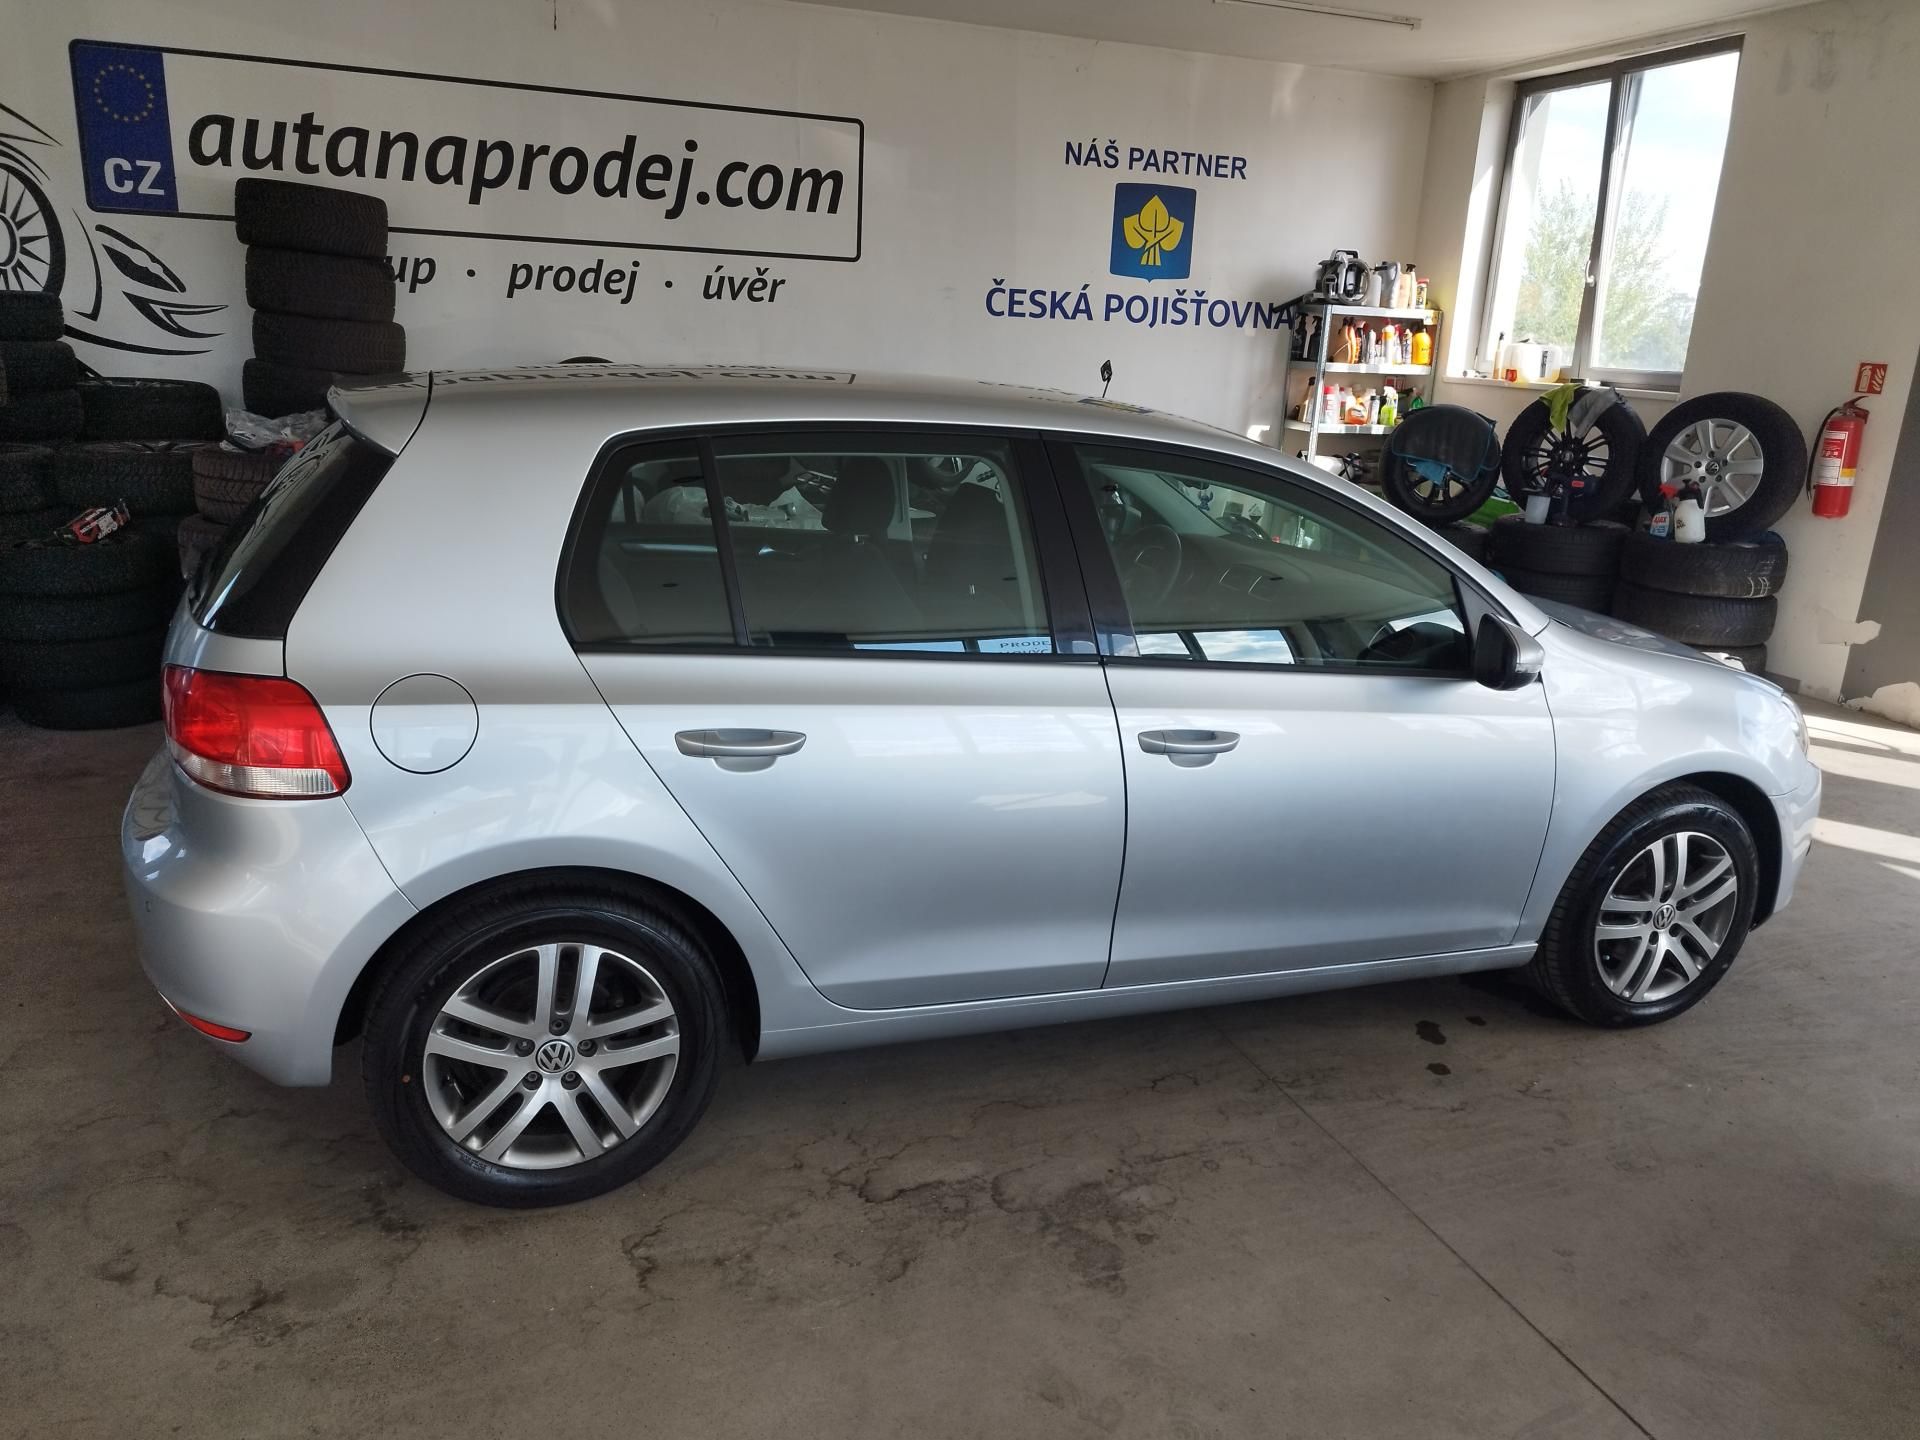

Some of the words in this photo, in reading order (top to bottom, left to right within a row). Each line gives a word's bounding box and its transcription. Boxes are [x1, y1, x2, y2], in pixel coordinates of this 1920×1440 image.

[104, 156, 165, 195] CZ
[188, 111, 844, 220] autanaprodej.com
[1064, 137, 1120, 169] NÁŠ
[1128, 146, 1247, 180] PARTNER
[386, 255, 437, 294] up
[506, 258, 641, 305] prodej
[702, 264, 788, 303] úvěr
[985, 278, 1094, 322] ČESKÁ
[1104, 288, 1294, 330] POJIŠŤOVNA
[1000, 640, 1052, 648] PRODE
